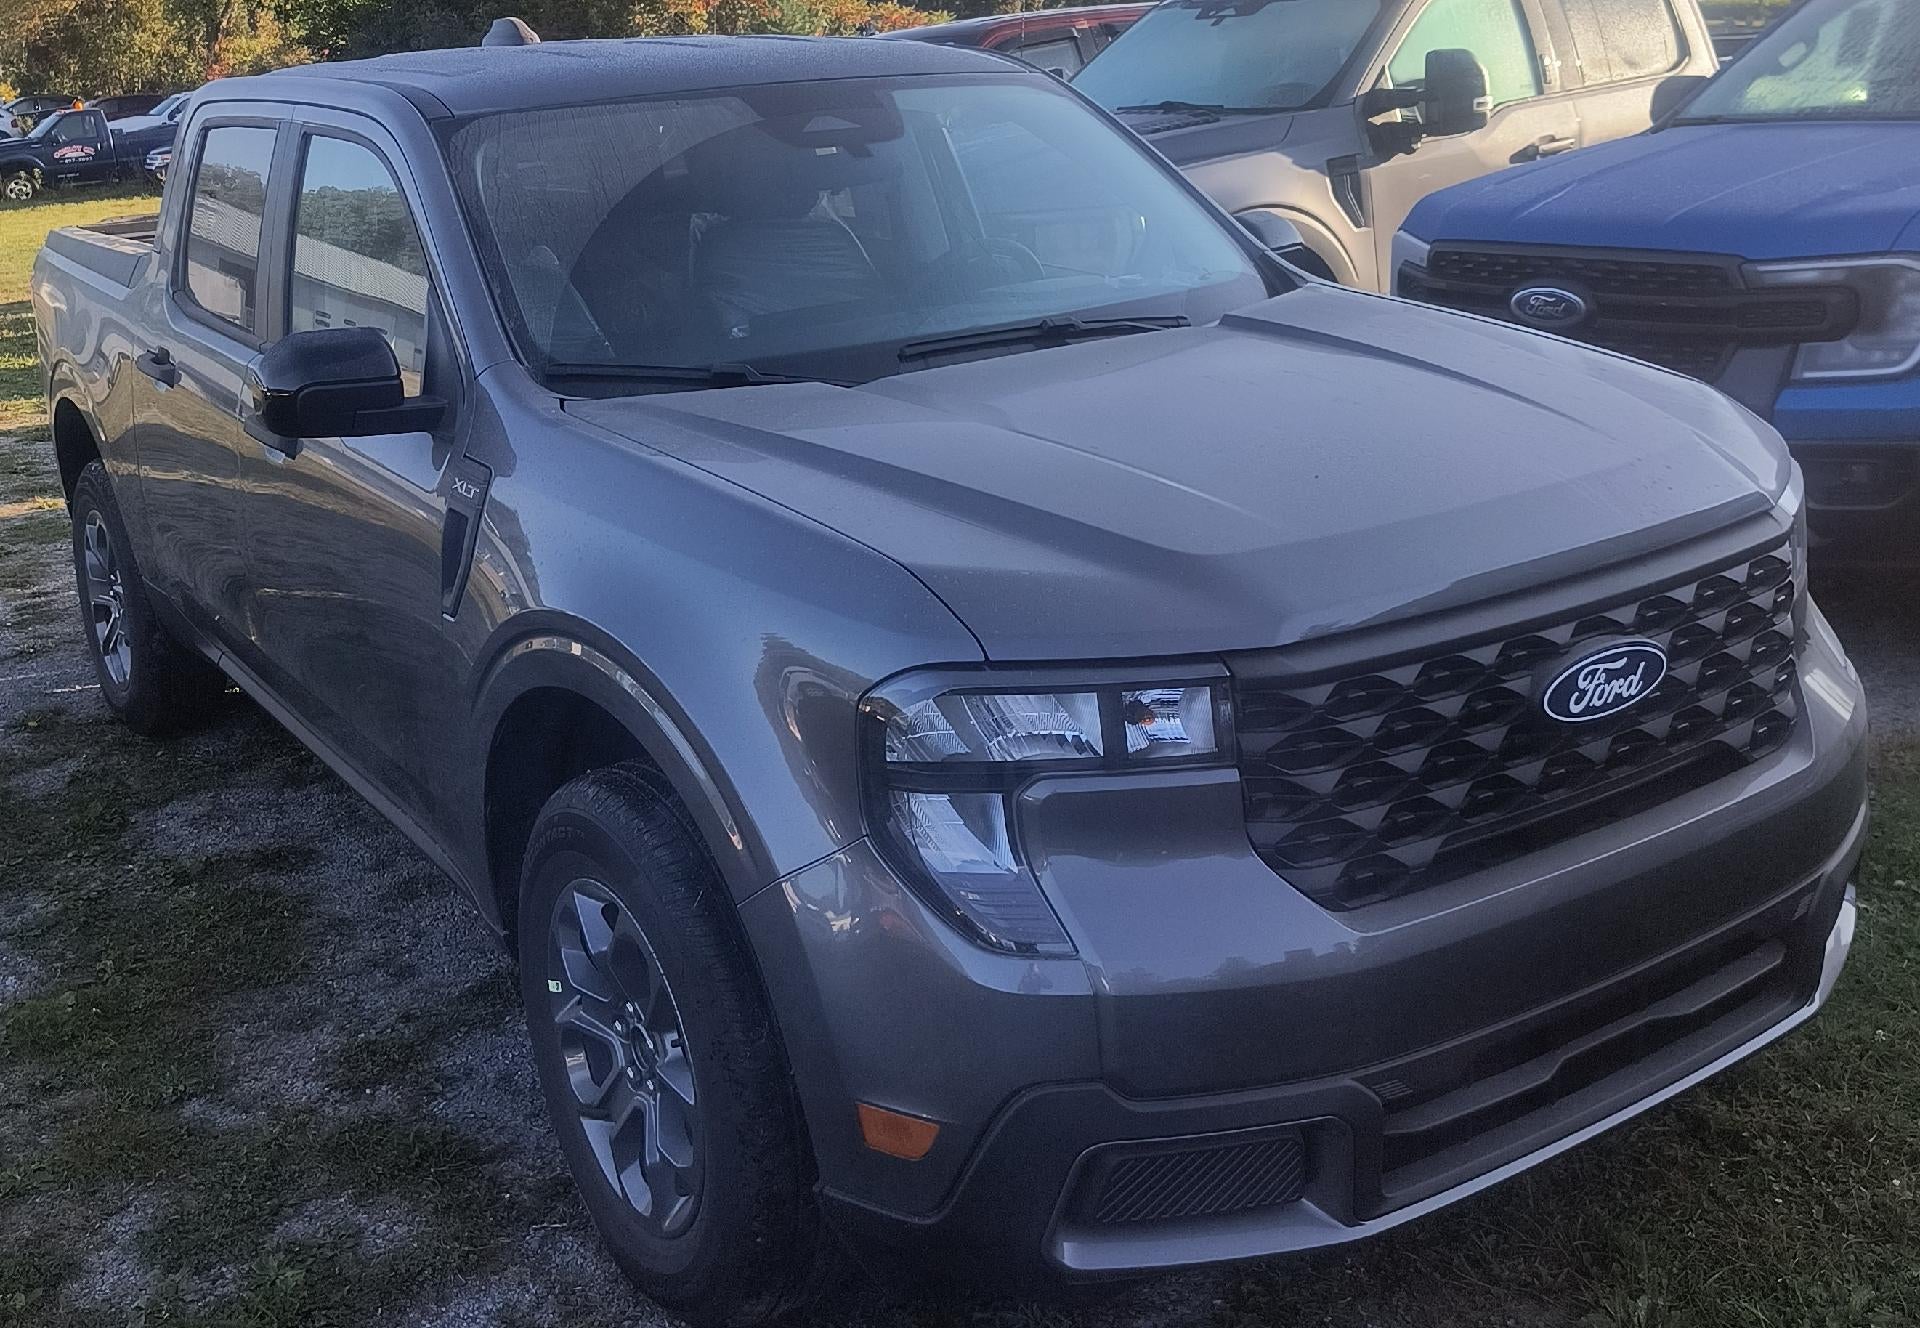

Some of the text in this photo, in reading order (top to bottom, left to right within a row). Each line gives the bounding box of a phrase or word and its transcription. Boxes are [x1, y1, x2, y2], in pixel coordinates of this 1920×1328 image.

[1526, 295, 1566, 317] Ford
[452, 477, 480, 499] XLT
[1569, 656, 1646, 714] Ford
